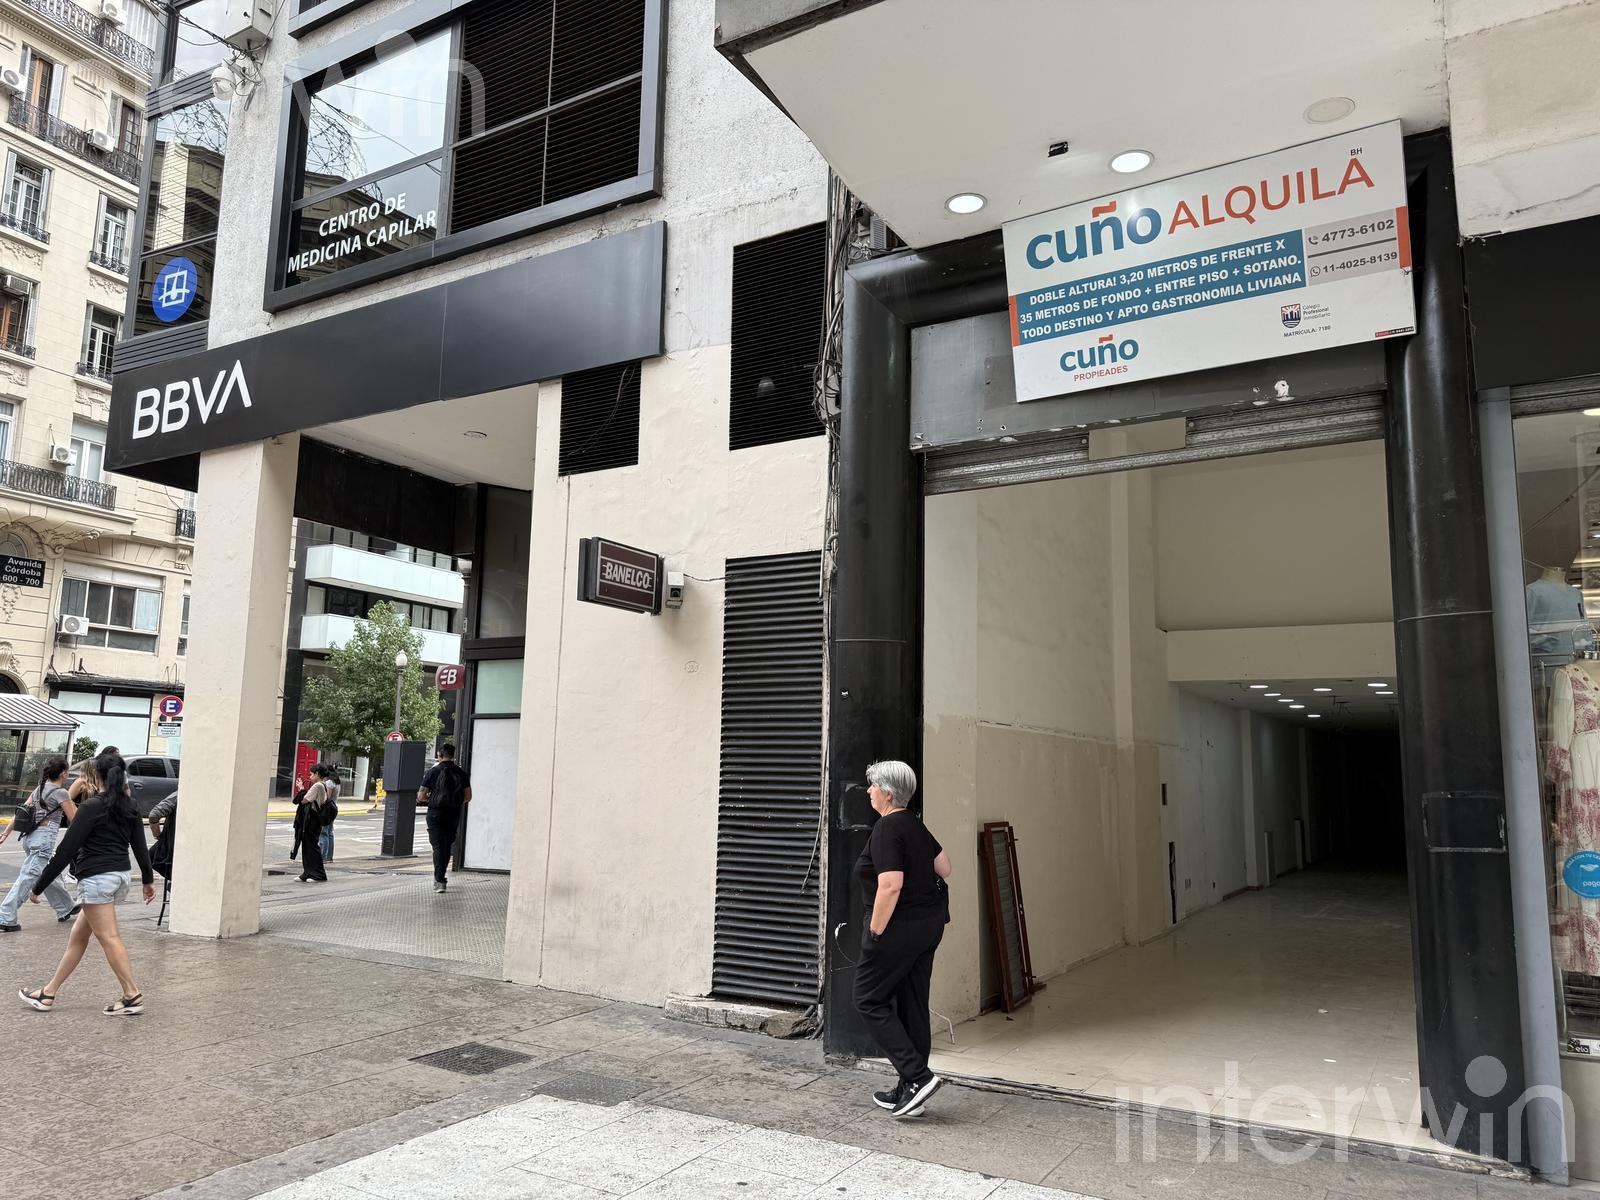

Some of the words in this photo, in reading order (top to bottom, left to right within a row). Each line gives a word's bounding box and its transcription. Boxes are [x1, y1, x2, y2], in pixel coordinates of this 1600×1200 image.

[1350, 147, 1363, 156] BH
[319, 202, 380, 237] CENTRO
[384, 192, 407, 216] DE
[1026, 200, 1162, 270] cuño
[1168, 157, 1375, 234] ALQUILA
[288, 234, 362, 273] MEDICINA
[366, 210, 437, 247] CAPILAR
[1321, 218, 1395, 243] 4773-6102
[1029, 288, 1066, 306] DOBLE
[1068, 276, 1118, 297] ALTURA!
[1120, 271, 1144, 287] 3,20
[1147, 258, 1198, 278] METROS
[1201, 254, 1218, 266] DE
[1221, 242, 1273, 262] FRENTE
[1275, 238, 1286, 250] X
[1322, 251, 1398, 273] 11-4025-8139
[1019, 312, 1033, 324] 35
[1035, 302, 1080, 320] METROS
[1083, 297, 1099, 309] DE
[1101, 288, 1142, 305] FONDO
[1144, 287, 1152, 295] +
[1155, 276, 1196, 294] ENTRE
[1199, 269, 1229, 284] PISO
[1232, 268, 1240, 276] +
[1243, 254, 1302, 275] SOTANO.
[1022, 324, 1052, 339] TODO
[1054, 313, 1103, 333] DESTINO
[1105, 310, 1115, 321] Y
[1117, 303, 1149, 319] APTO
[1151, 283, 1245, 312] GASTRONOMIA
[1247, 272, 1302, 292] LIVIANA
[1303, 306, 1330, 316] Profesional
[1059, 334, 1139, 372] cuño
[1073, 365, 1128, 382] PROPIEADES
[132, 359, 252, 440] BBVA
[5, 564, 41, 577] Córdoba
[7, 556, 42, 569] Avenida
[604, 561, 651, 589] BANELCO
[2, 574, 18, 583] 600
[25, 577, 40, 586] 700
[165, 699, 177, 713] E
